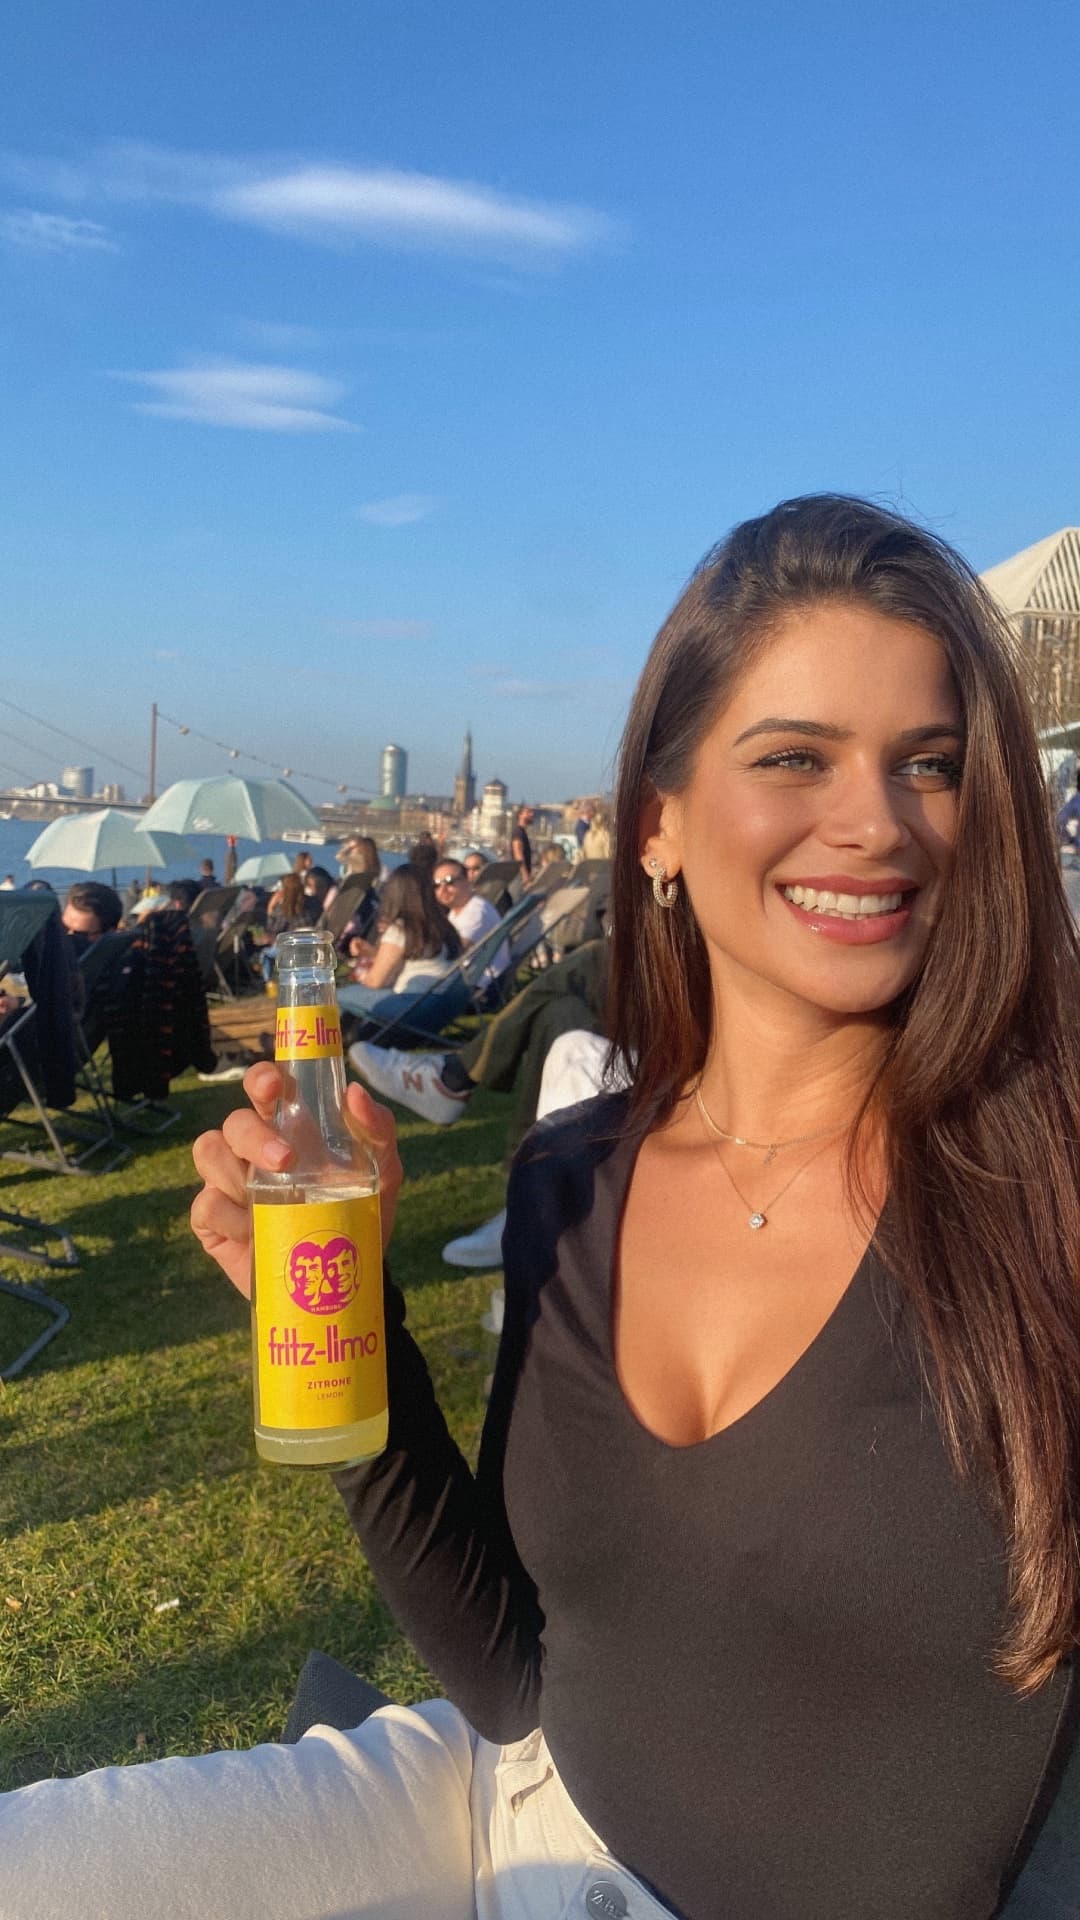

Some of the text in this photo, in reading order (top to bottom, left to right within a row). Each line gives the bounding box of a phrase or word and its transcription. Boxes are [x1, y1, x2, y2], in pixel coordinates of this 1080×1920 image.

[402, 1071, 424, 1092] N
[269, 1325, 377, 1365] fritz-limo
[307, 1377, 352, 1389] ZITRONE
[317, 1392, 344, 1400] LEMON
